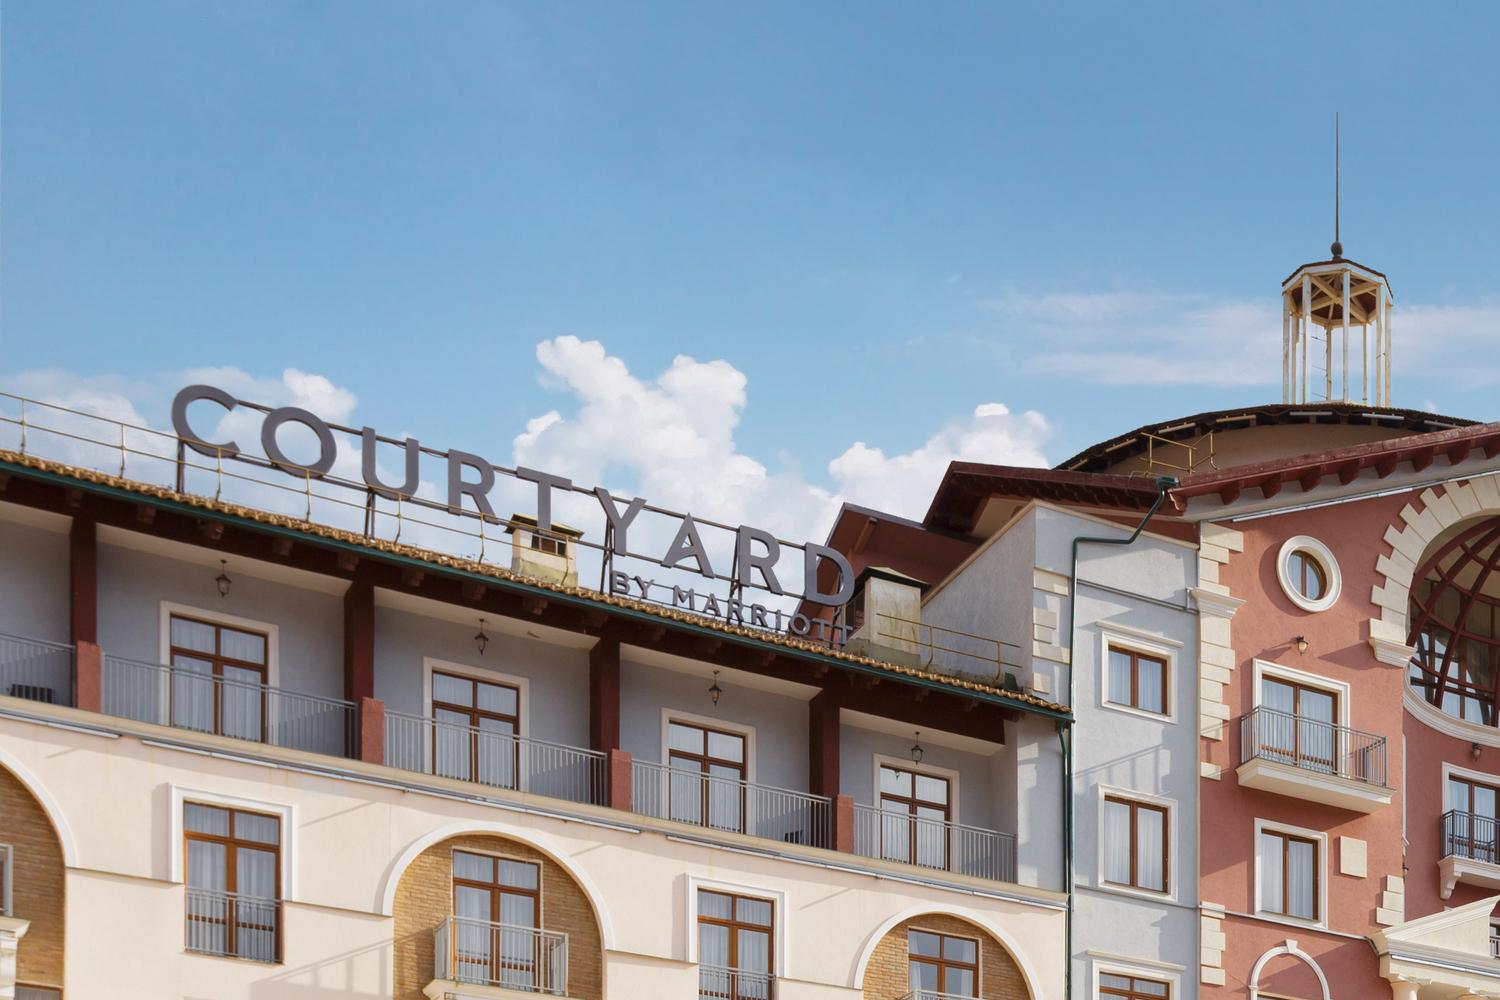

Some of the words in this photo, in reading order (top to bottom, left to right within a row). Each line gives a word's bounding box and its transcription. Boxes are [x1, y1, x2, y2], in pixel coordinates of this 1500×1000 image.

[170, 384, 857, 607] COURTYARD
[612, 570, 655, 601] BY
[672, 584, 854, 646] MARRIOTT
